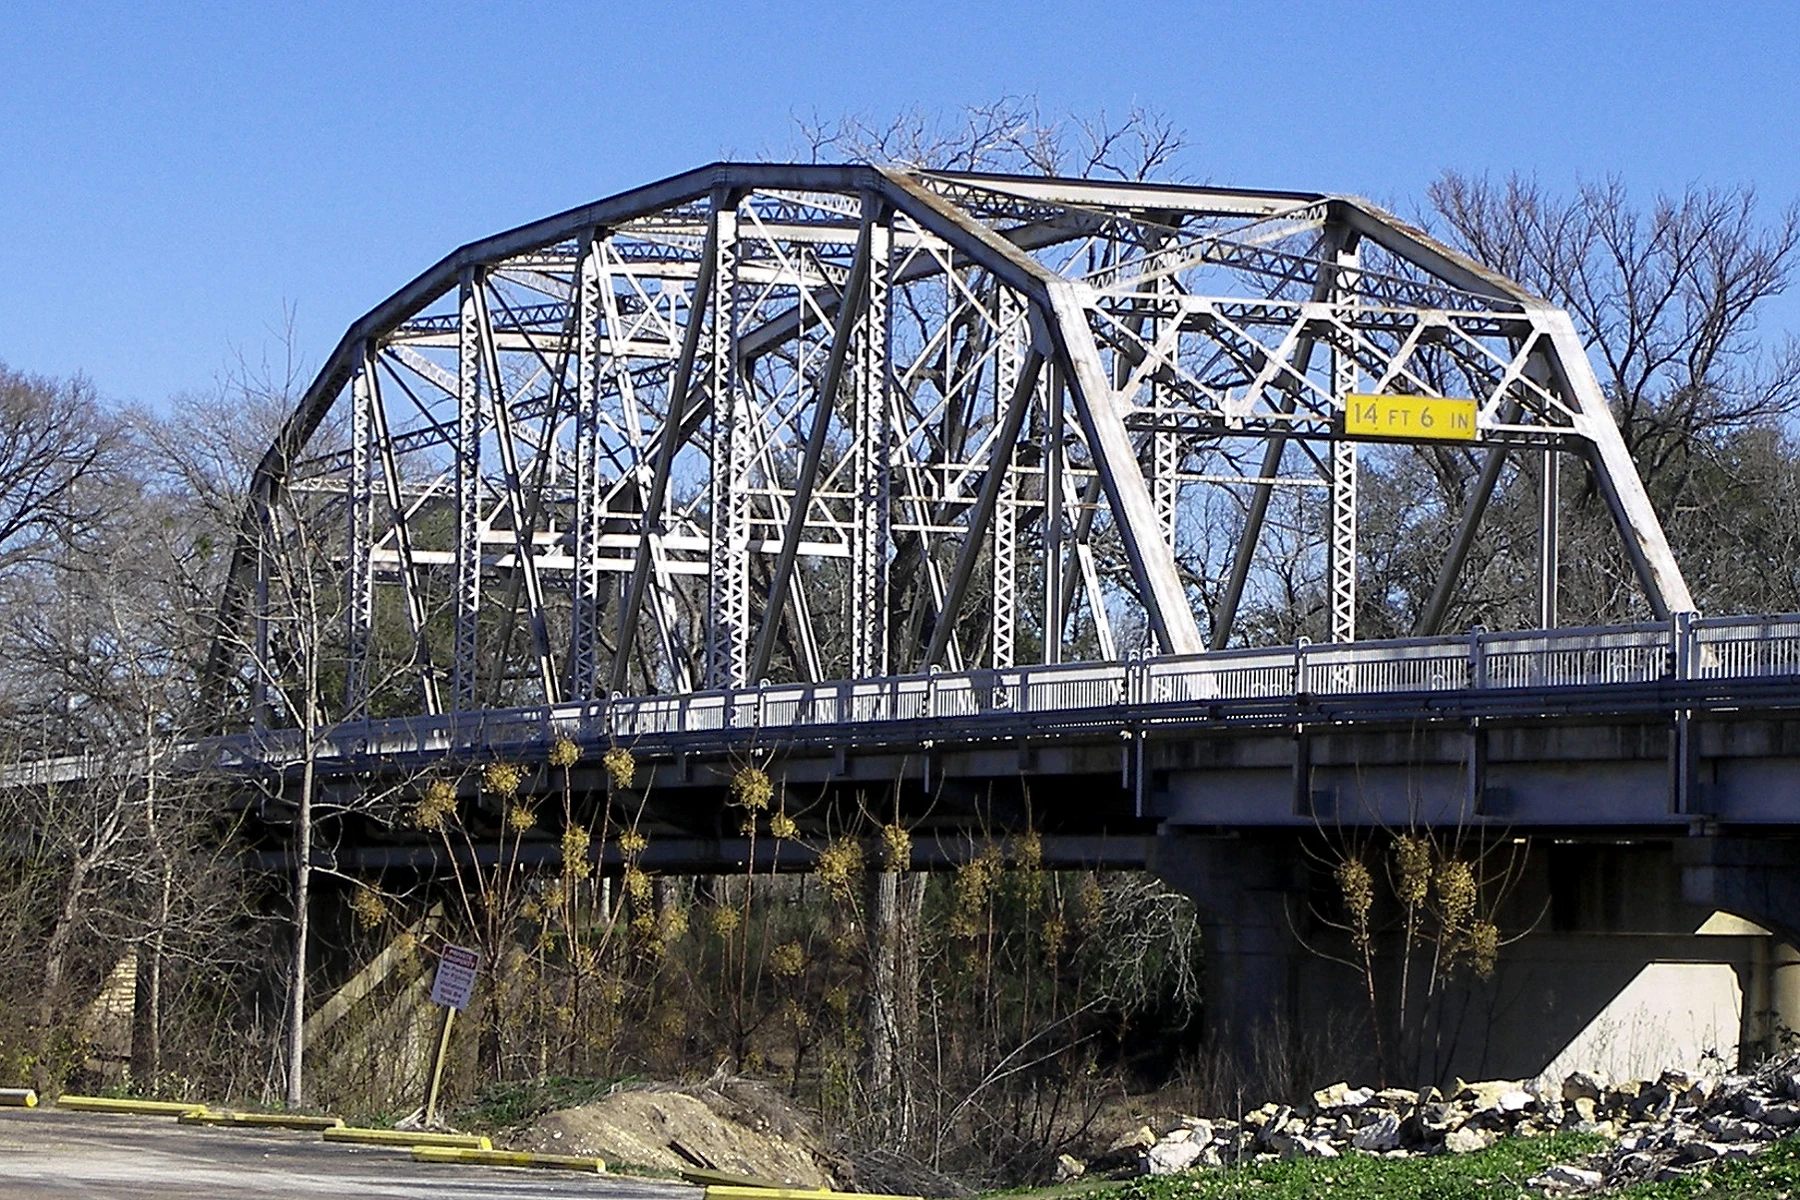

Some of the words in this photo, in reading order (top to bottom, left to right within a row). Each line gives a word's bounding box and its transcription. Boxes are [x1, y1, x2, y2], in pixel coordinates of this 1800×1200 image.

[1354, 402, 1378, 424] 14
[1388, 409, 1411, 426] FT
[1420, 406, 1434, 428] 6
[1451, 412, 1469, 429] IN
